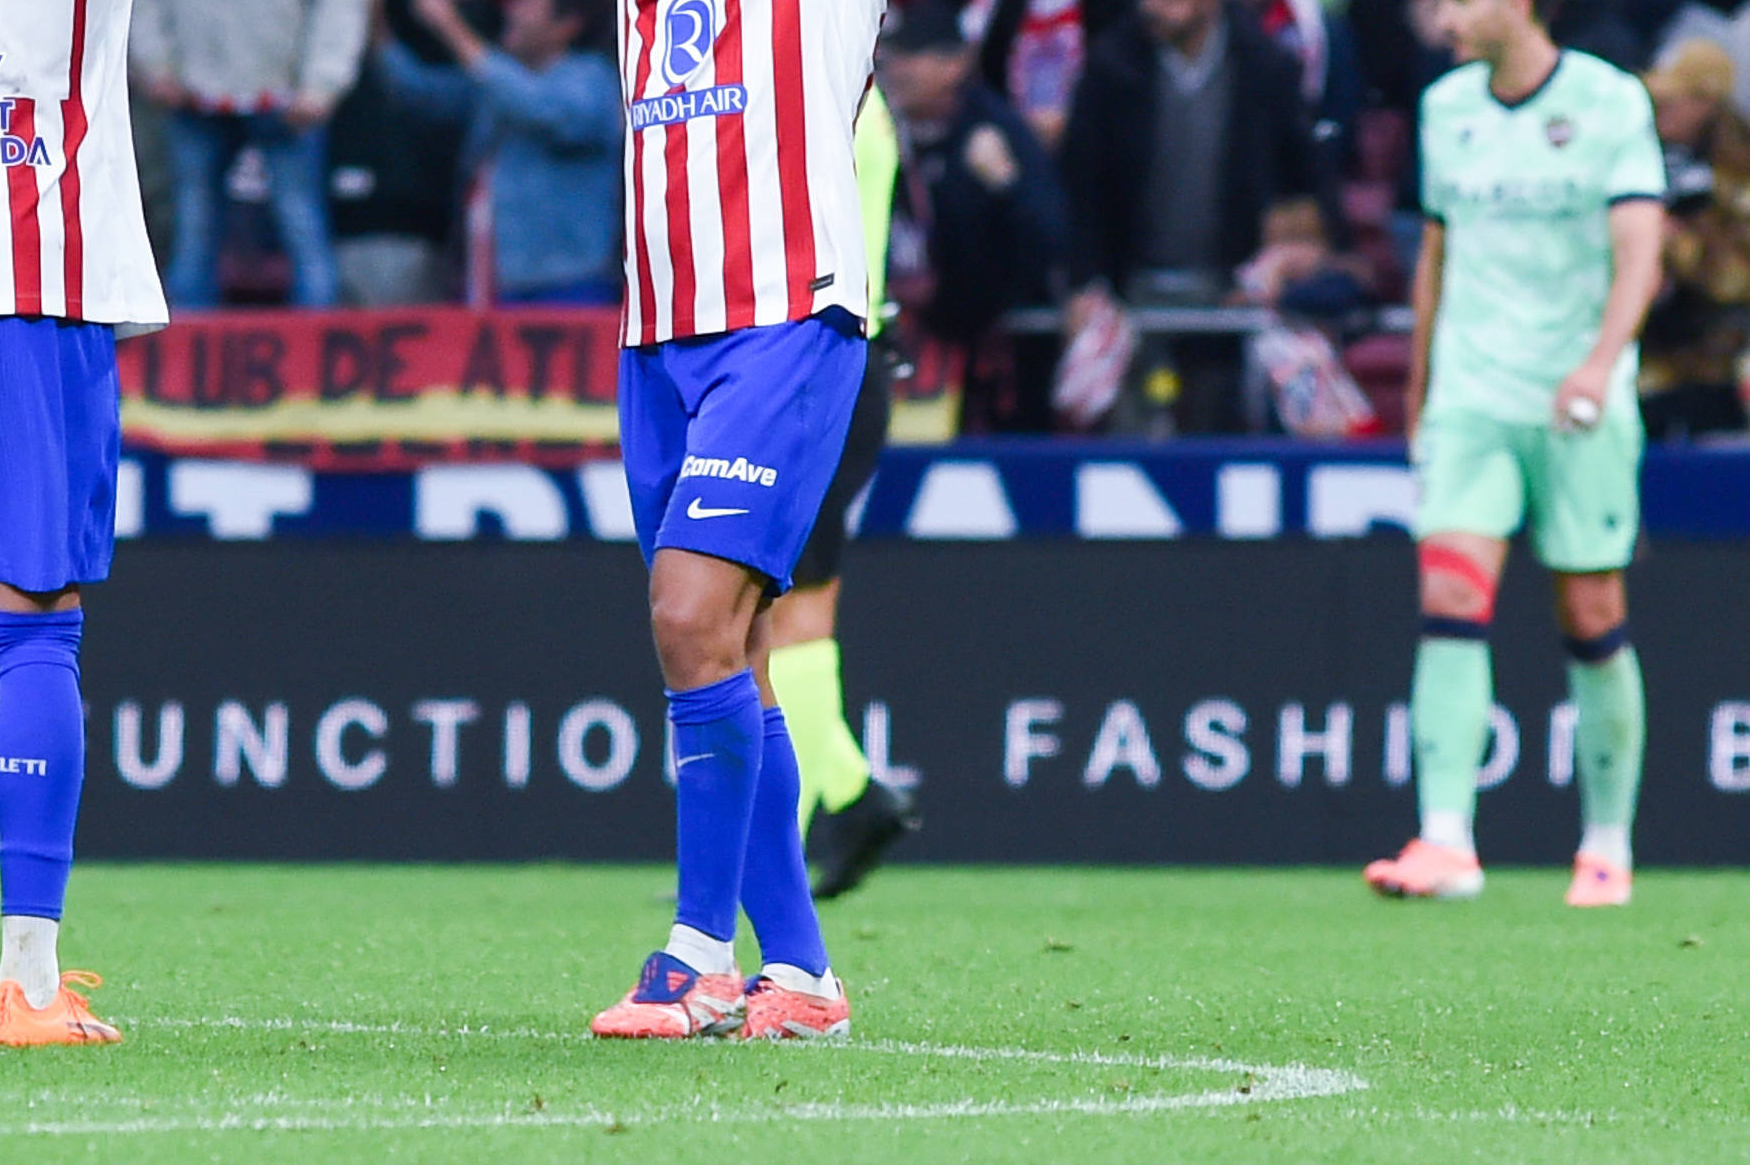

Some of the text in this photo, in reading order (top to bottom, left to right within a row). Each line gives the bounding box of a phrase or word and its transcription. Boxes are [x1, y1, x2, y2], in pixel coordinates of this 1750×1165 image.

[632, 87, 744, 128] RIYADH AIR
[680, 455, 778, 487] ComAve
[112, 699, 922, 788] UNCTIOL
